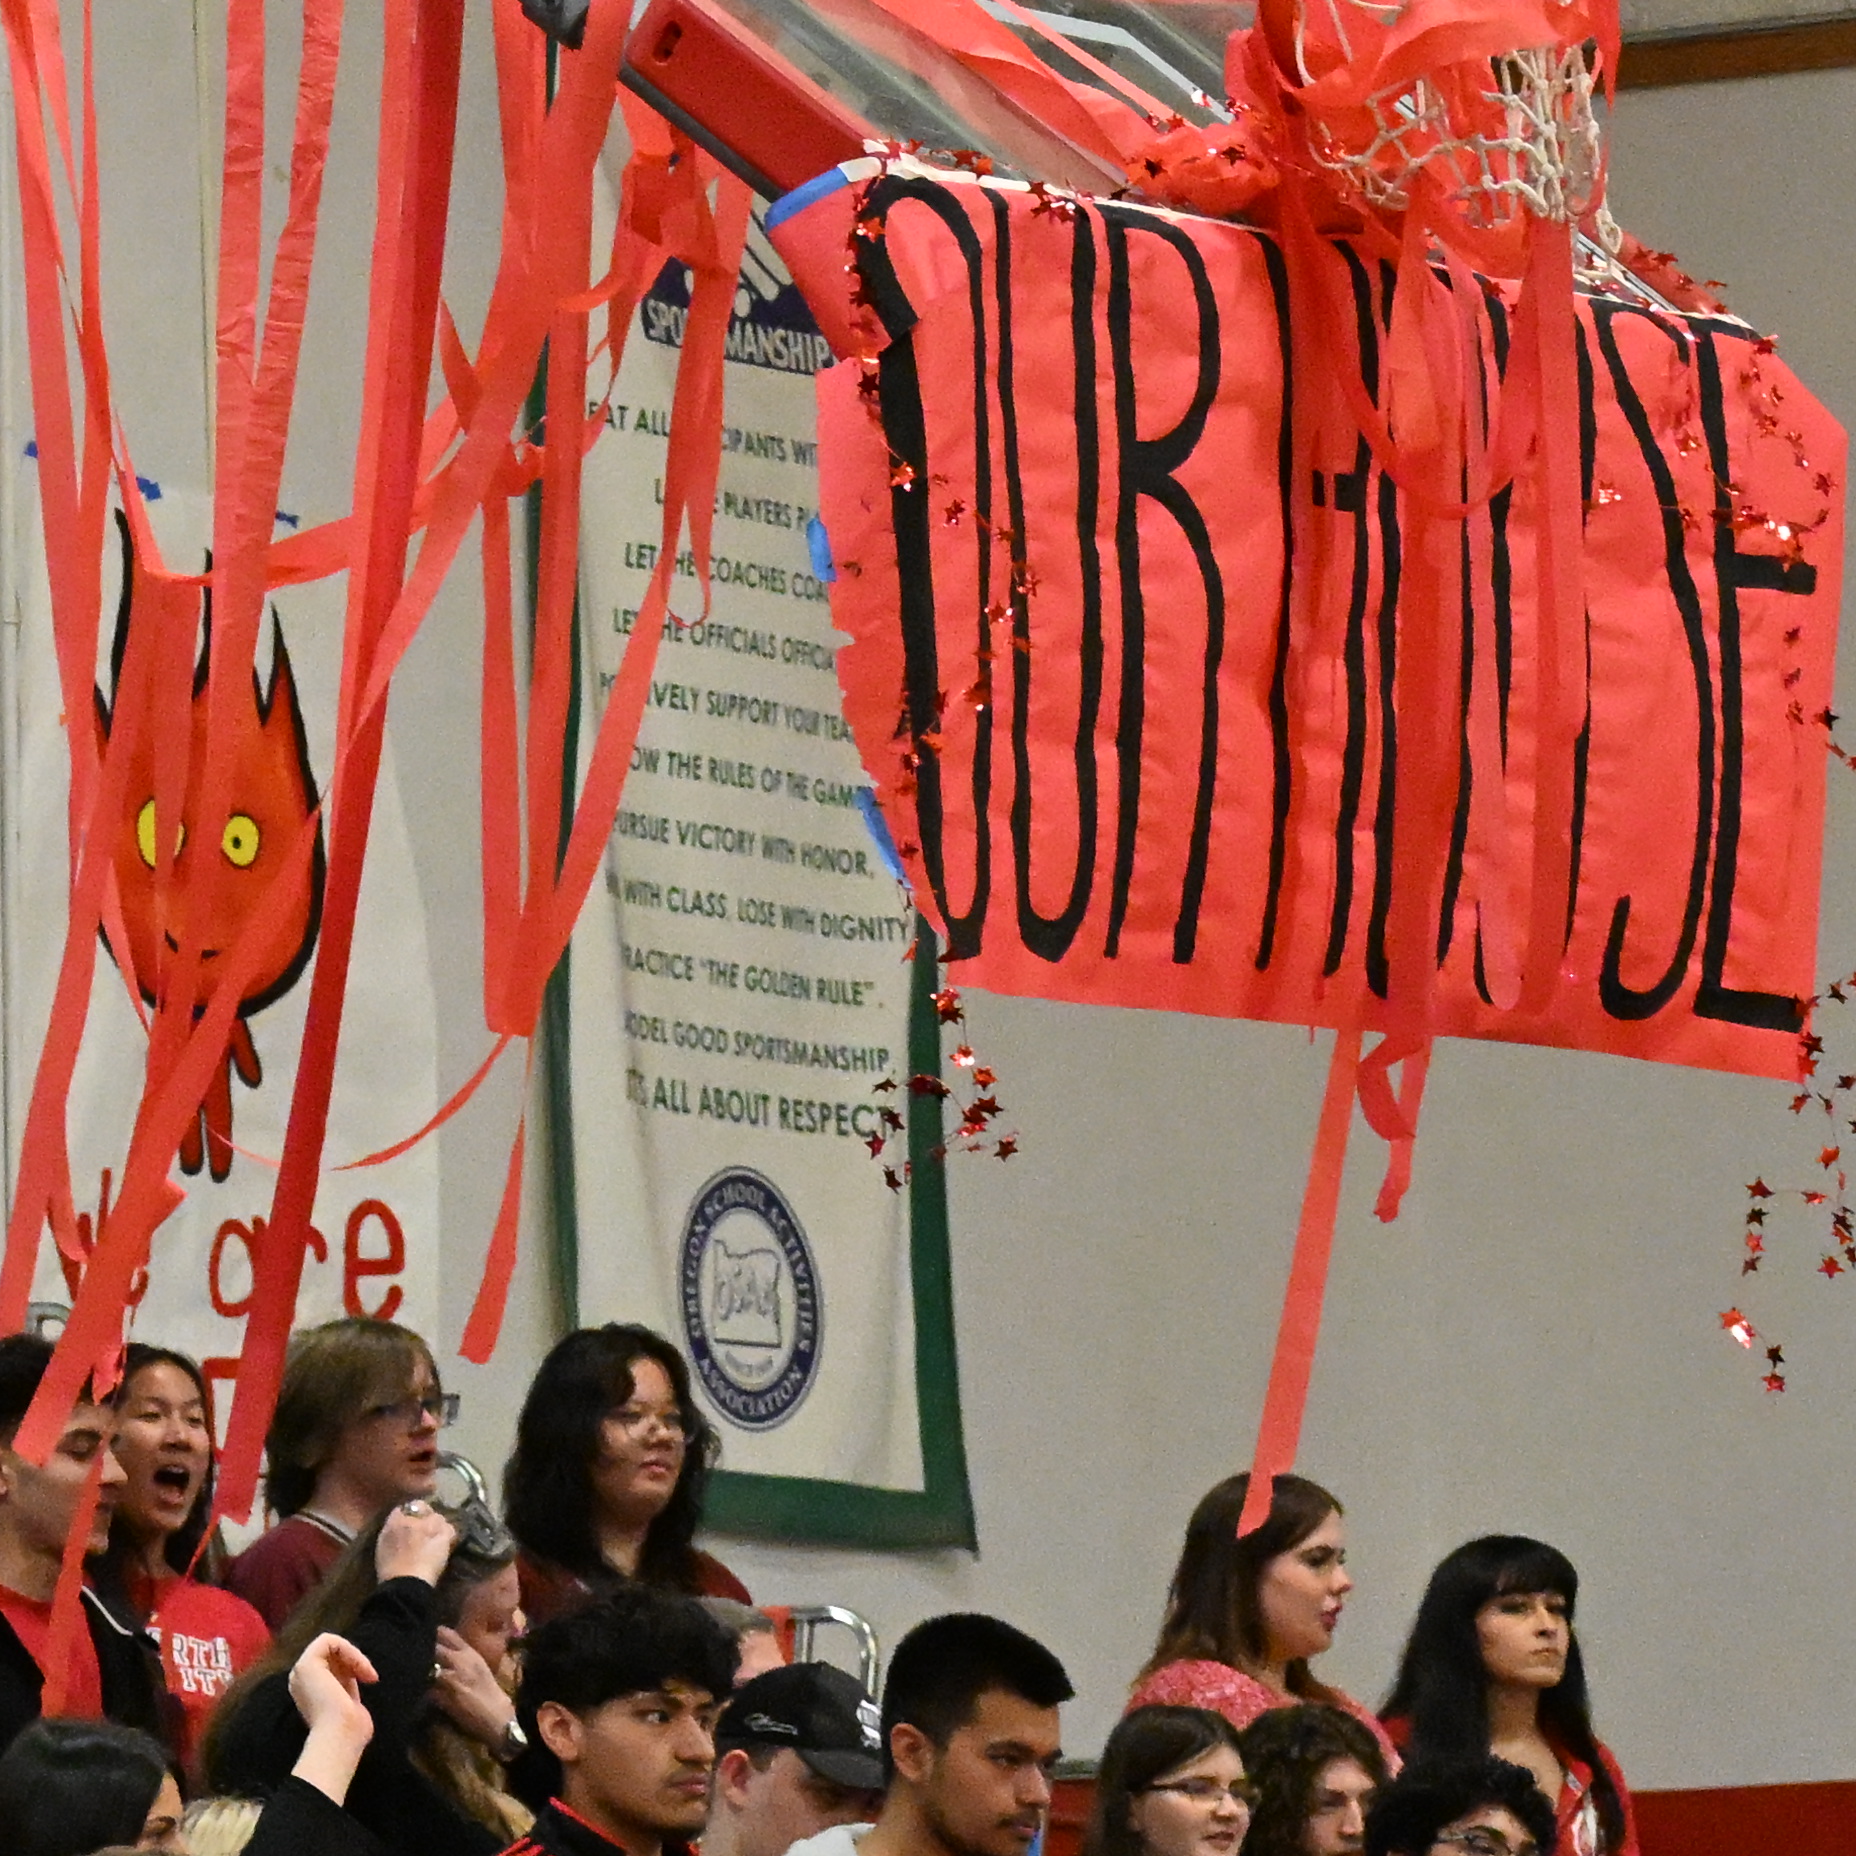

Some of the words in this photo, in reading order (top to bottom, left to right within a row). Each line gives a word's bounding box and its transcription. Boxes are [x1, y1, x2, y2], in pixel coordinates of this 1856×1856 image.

[674, 551, 694, 577] HE
[823, 713, 855, 743] TEA
[667, 750, 703, 782] THE
[673, 1019, 728, 1055] GOOD
[652, 1076, 692, 1115] ALL
[698, 1083, 772, 1127] ABOUT
